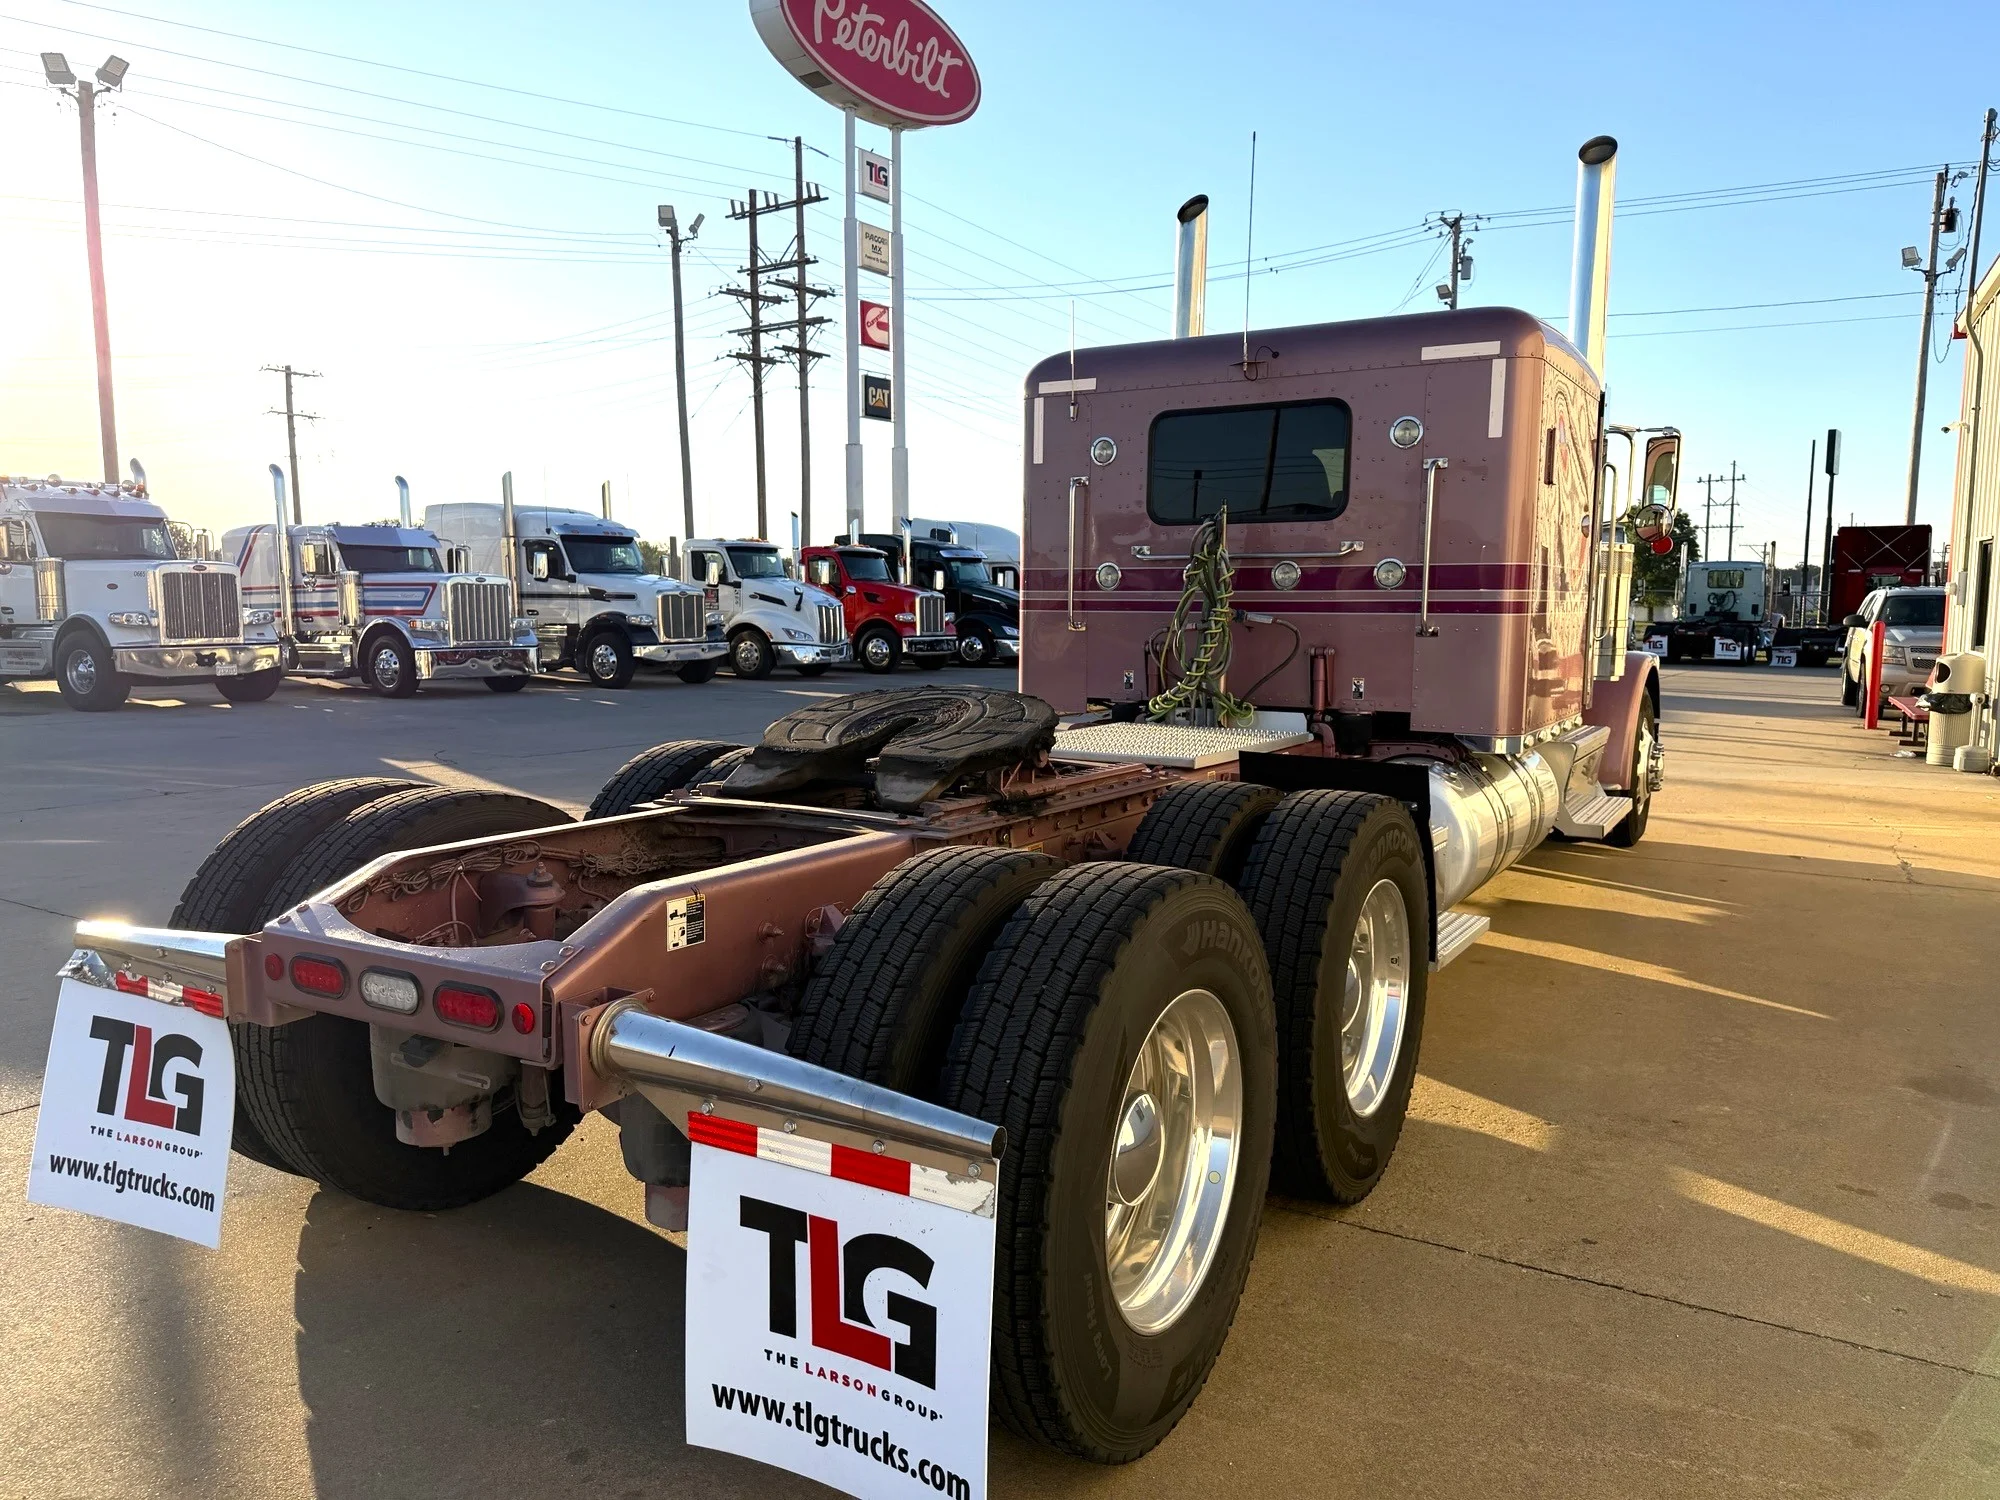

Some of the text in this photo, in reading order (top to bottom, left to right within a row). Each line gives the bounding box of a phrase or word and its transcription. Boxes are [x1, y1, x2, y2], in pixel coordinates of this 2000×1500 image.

[814, 0, 963, 98] Peterbilt
[866, 160, 888, 187] TLG
[871, 244, 882, 254] MX
[868, 386, 890, 409] CAT
[1648, 640, 1664, 650] TLG
[1719, 642, 1737, 652] TLG
[1775, 655, 1792, 665] TLG
[89, 1015, 206, 1137] TLG
[90, 1125, 202, 1159] THE LARSON GROUP
[49, 1153, 216, 1213] www.tlgtrucks.com
[739, 1194, 937, 1391] TLG
[764, 1347, 939, 1422] THE LARSON GROUP
[711, 1382, 971, 1500] www.tlgtrucks.com
